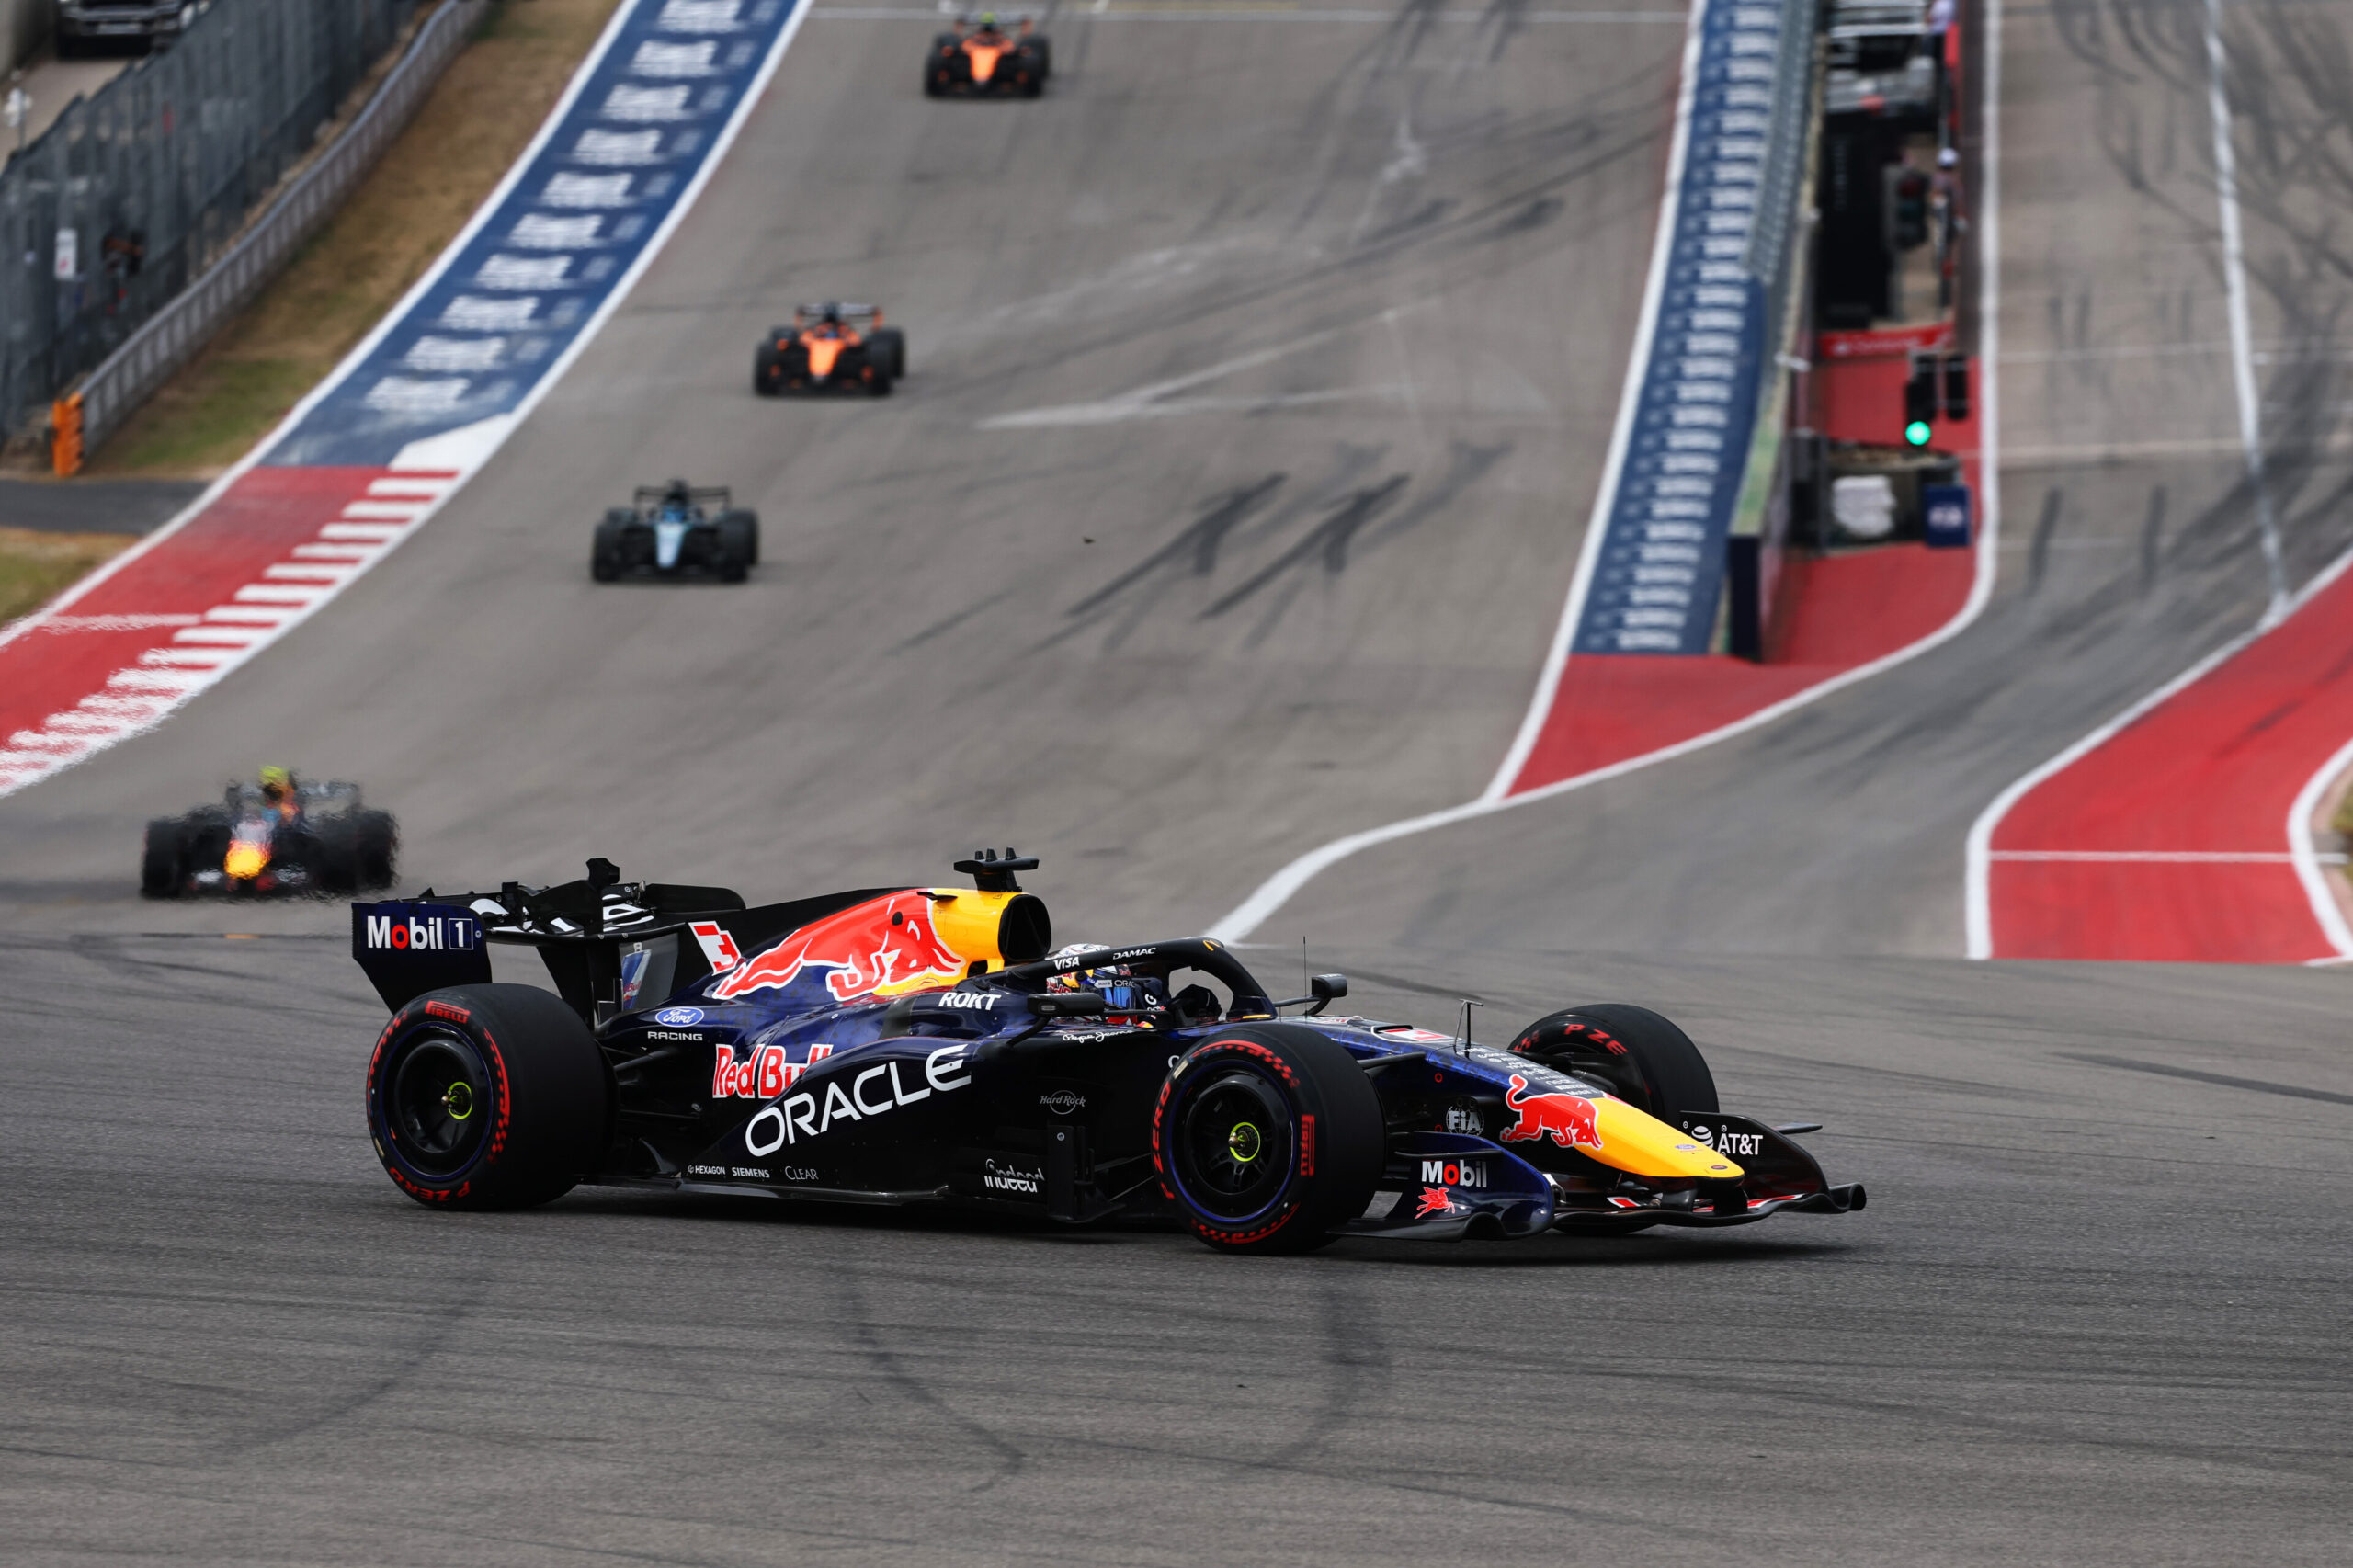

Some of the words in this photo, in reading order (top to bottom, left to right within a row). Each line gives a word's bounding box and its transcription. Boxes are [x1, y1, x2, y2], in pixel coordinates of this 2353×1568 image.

[368, 916, 443, 949] Mobil
[1053, 957, 1080, 971] VISA
[1112, 947, 1156, 960] DAMAC
[426, 1000, 471, 1024] PIRELLI
[938, 992, 1001, 1010] ROKT
[663, 1008, 694, 1024] Ford
[647, 1031, 703, 1041] RACING
[712, 1043, 765, 1099] Red
[745, 1043, 972, 1157] ORACLE
[1040, 1096, 1063, 1105] Hard
[1063, 1095, 1086, 1107] Rock
[1153, 1081, 1171, 1174] ZERO
[1301, 1114, 1315, 1176] PIRELLI
[1717, 1133, 1763, 1155] AT&T
[695, 1165, 726, 1176] HEXAGON
[732, 1167, 770, 1178] SIEMENS
[1421, 1159, 1487, 1187] Mobil
[389, 1167, 451, 1201] ZERO
